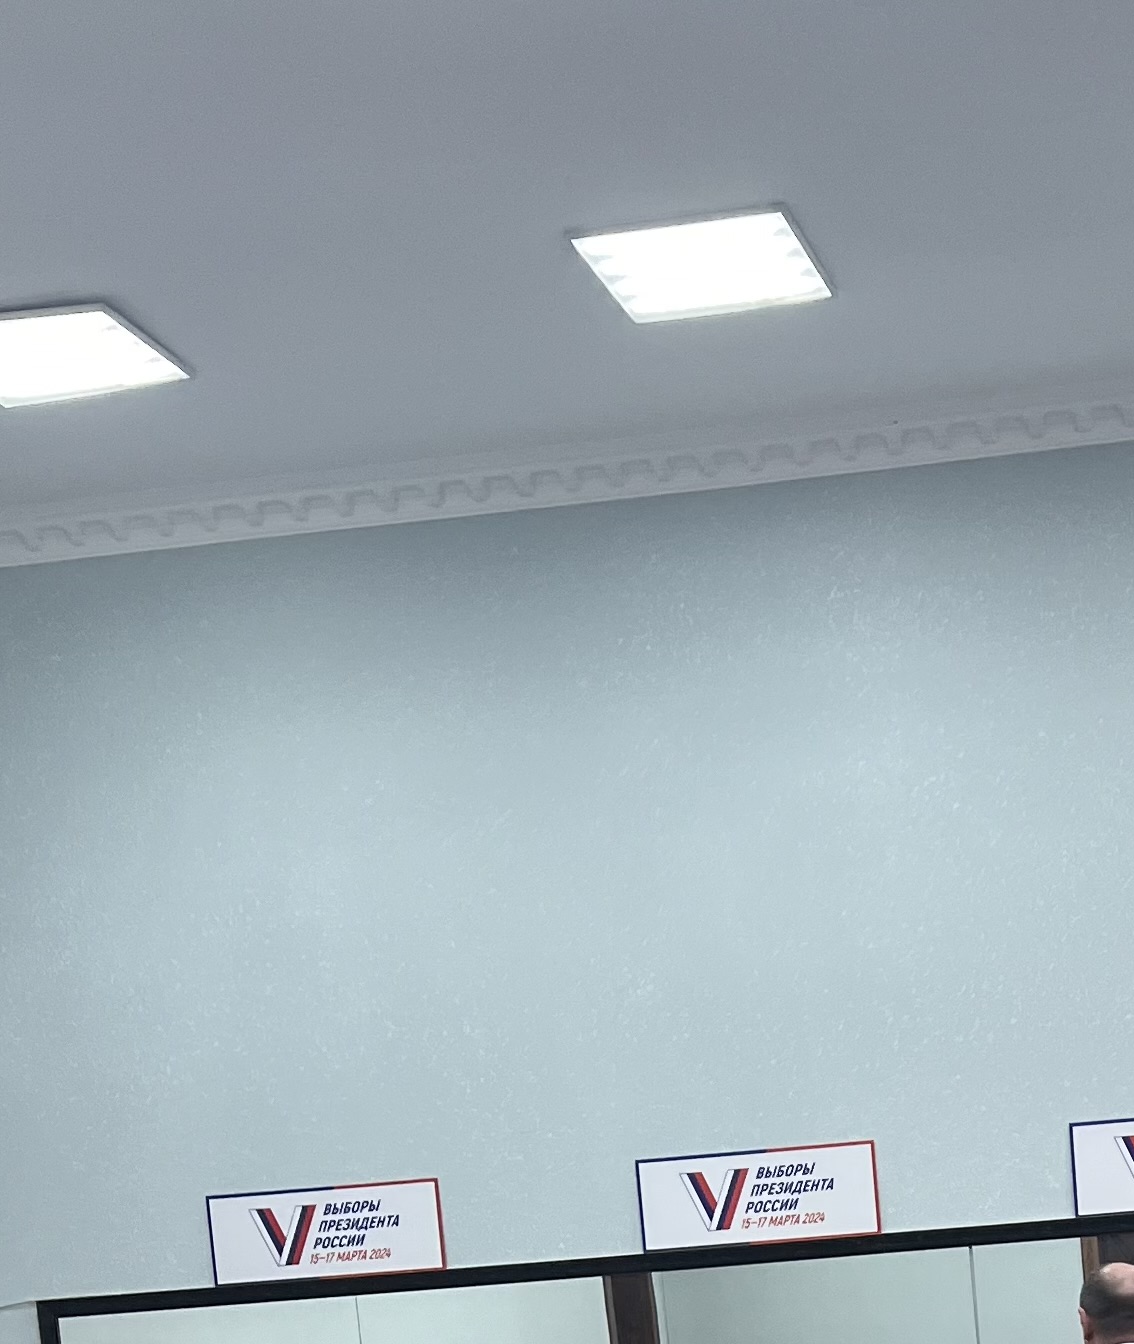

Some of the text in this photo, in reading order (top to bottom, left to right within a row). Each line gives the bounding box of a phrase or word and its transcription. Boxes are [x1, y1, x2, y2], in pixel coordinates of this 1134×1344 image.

[756, 1162, 815, 1179] ВЫБОРЫ
[750, 1178, 834, 1197] ПРЕЗИДЕНТА
[323, 1199, 381, 1215] ВЫБОРЫ
[745, 1198, 799, 1214] РОССИИ
[318, 1215, 399, 1233] ПРЕЗИДЕНТА
[768, 1213, 800, 1227] МАРТА
[802, 1212, 825, 1224] 2024
[313, 1234, 366, 1249] РОССИИ
[336, 1250, 367, 1262] МАРТА
[369, 1248, 391, 1260] 2024
